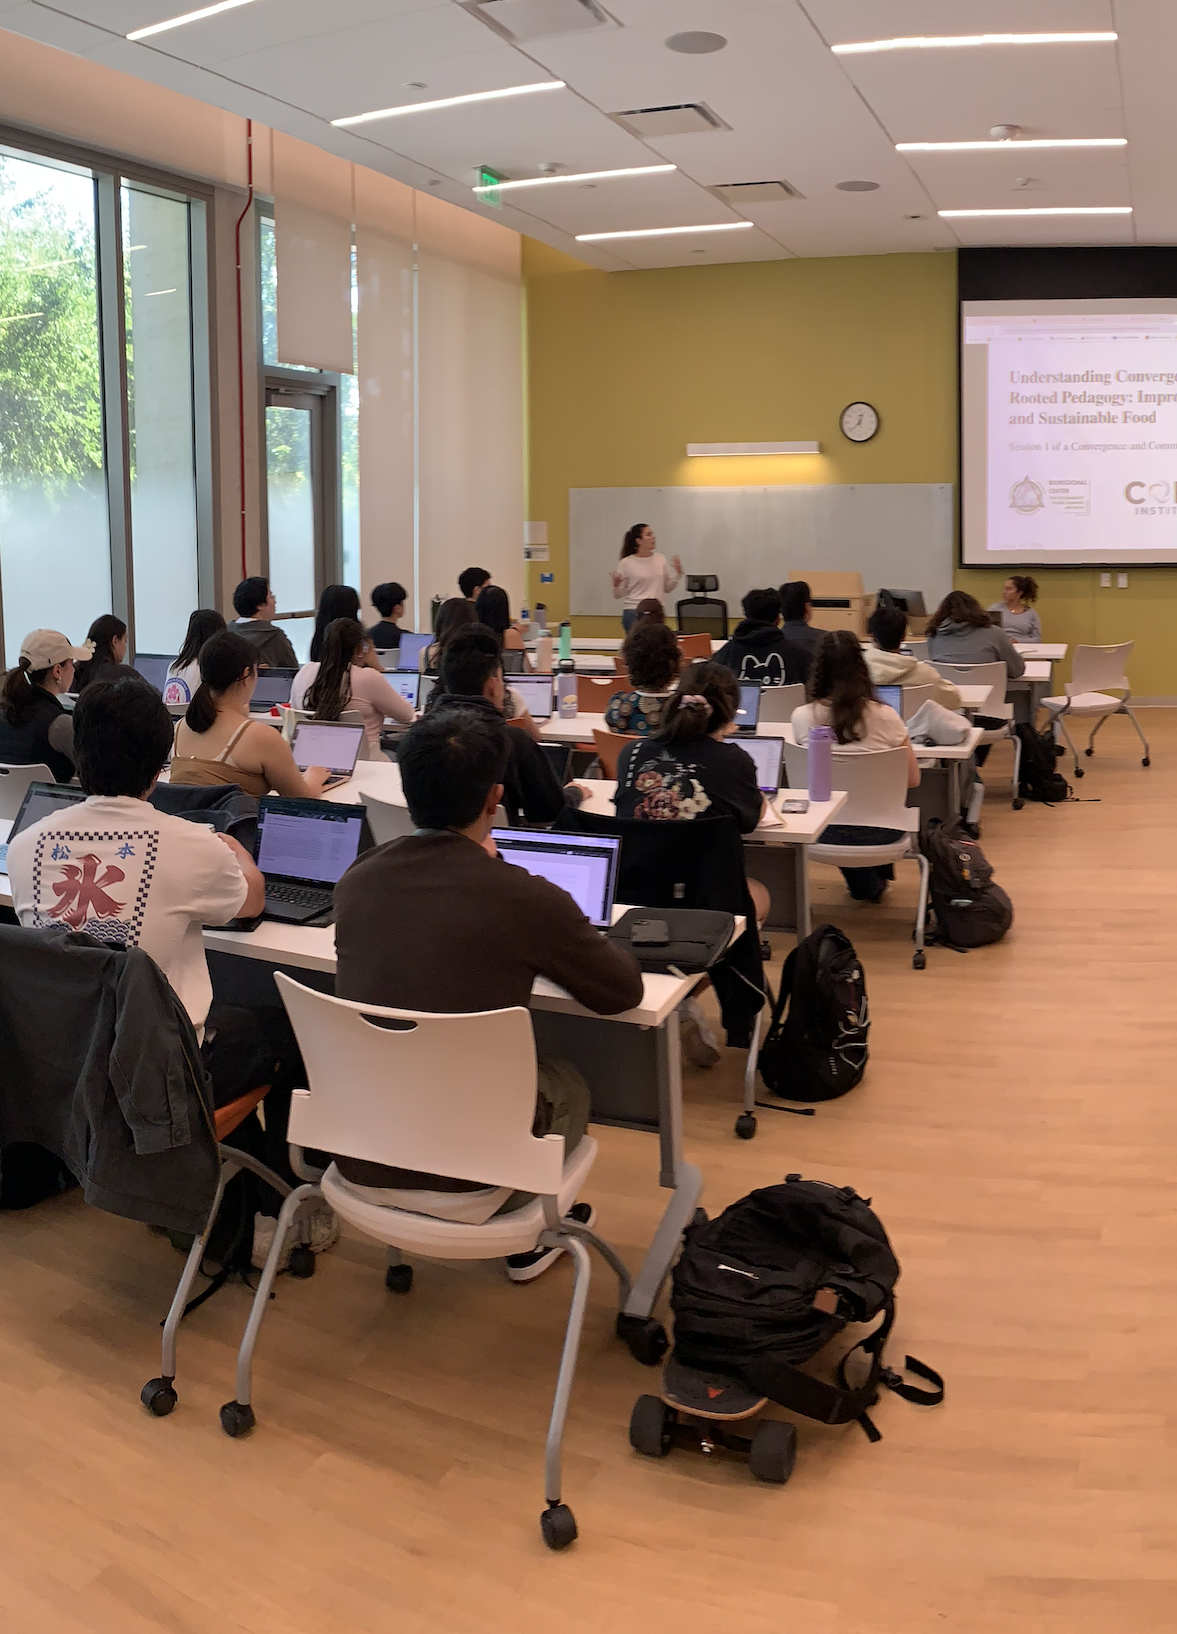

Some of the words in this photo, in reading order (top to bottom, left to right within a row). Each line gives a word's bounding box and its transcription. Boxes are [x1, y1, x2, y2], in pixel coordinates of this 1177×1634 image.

[1010, 370, 1112, 386] Understanding
[1009, 391, 1057, 404] Rooted
[1062, 391, 1133, 406] Pedagogy:
[1009, 412, 1034, 425] and
[1039, 411, 1118, 425] Sustainable
[1122, 410, 1157, 424] Food
[1009, 442, 1042, 451] Session
[1052, 442, 1062, 450] of
[1071, 441, 1127, 452] Convergence
[1130, 441, 1146, 450] and
[51, 843, 71, 861] 松
[114, 842, 136, 860] 本
